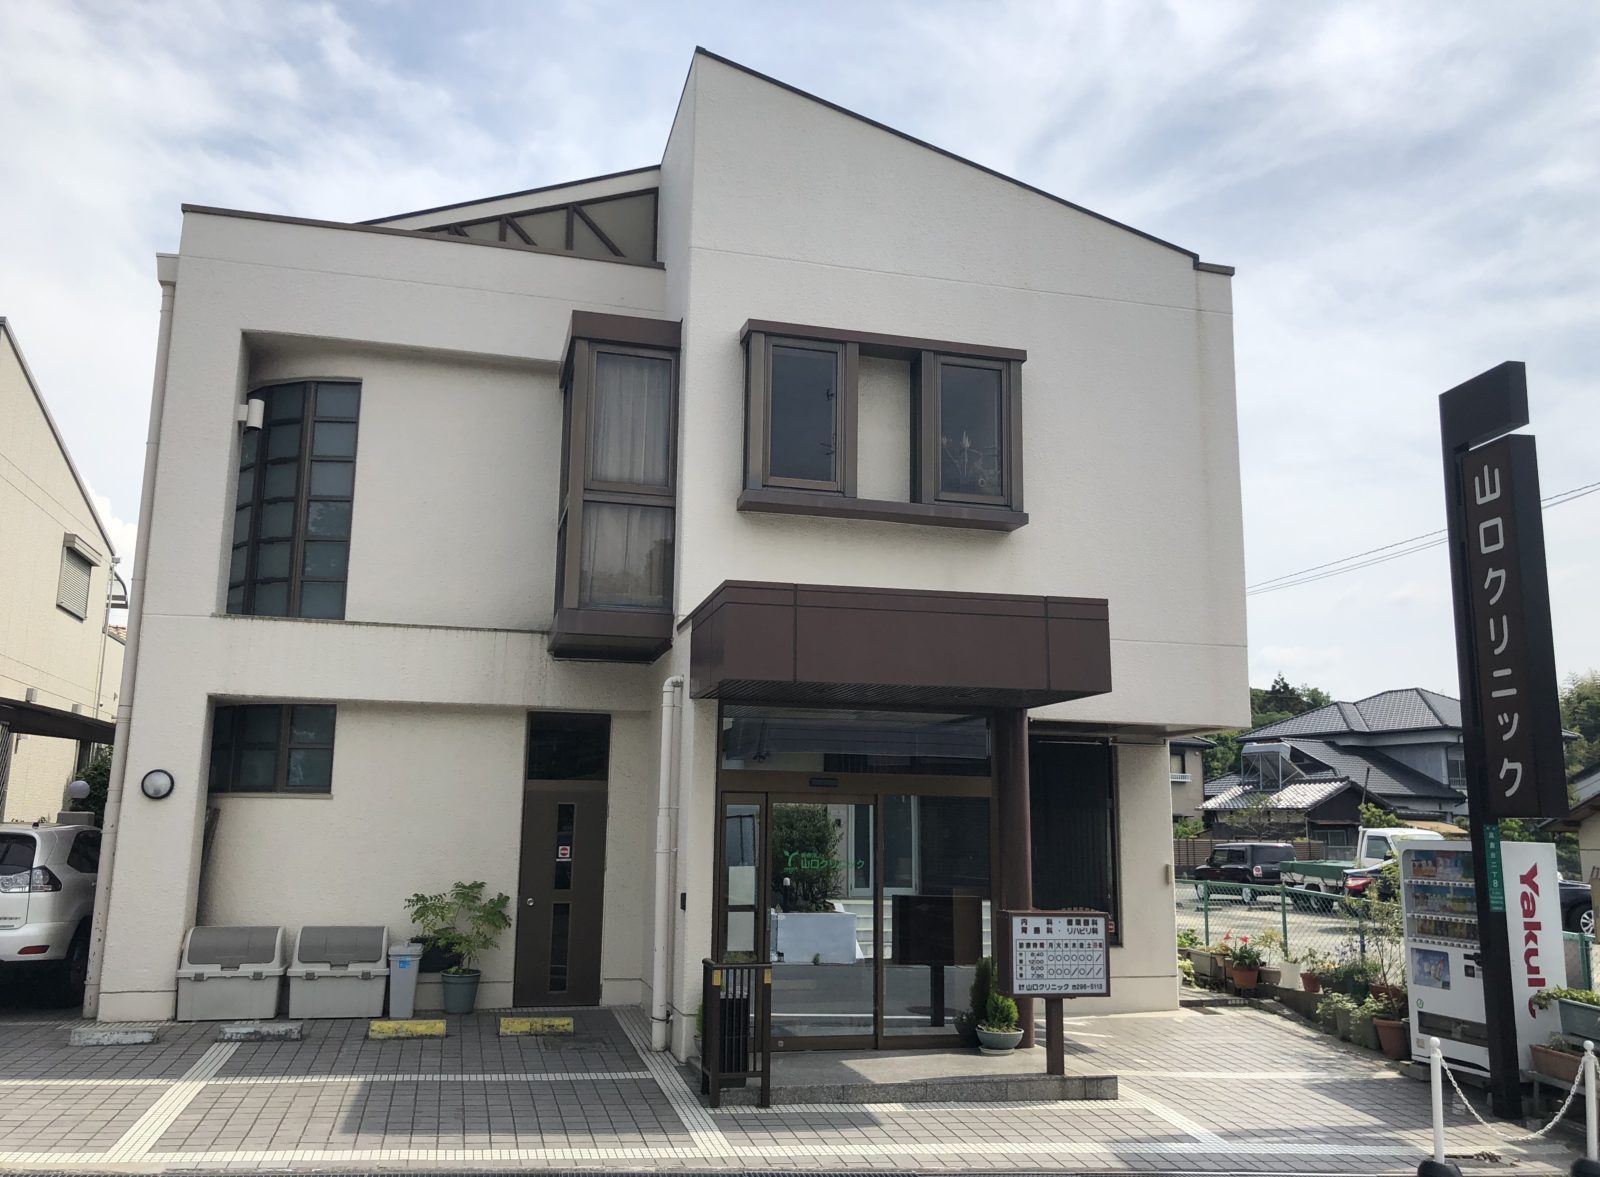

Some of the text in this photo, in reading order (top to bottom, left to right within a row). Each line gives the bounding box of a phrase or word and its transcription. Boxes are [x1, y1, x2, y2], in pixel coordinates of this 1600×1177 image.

[1474, 464, 1523, 798] 山口クリニック
